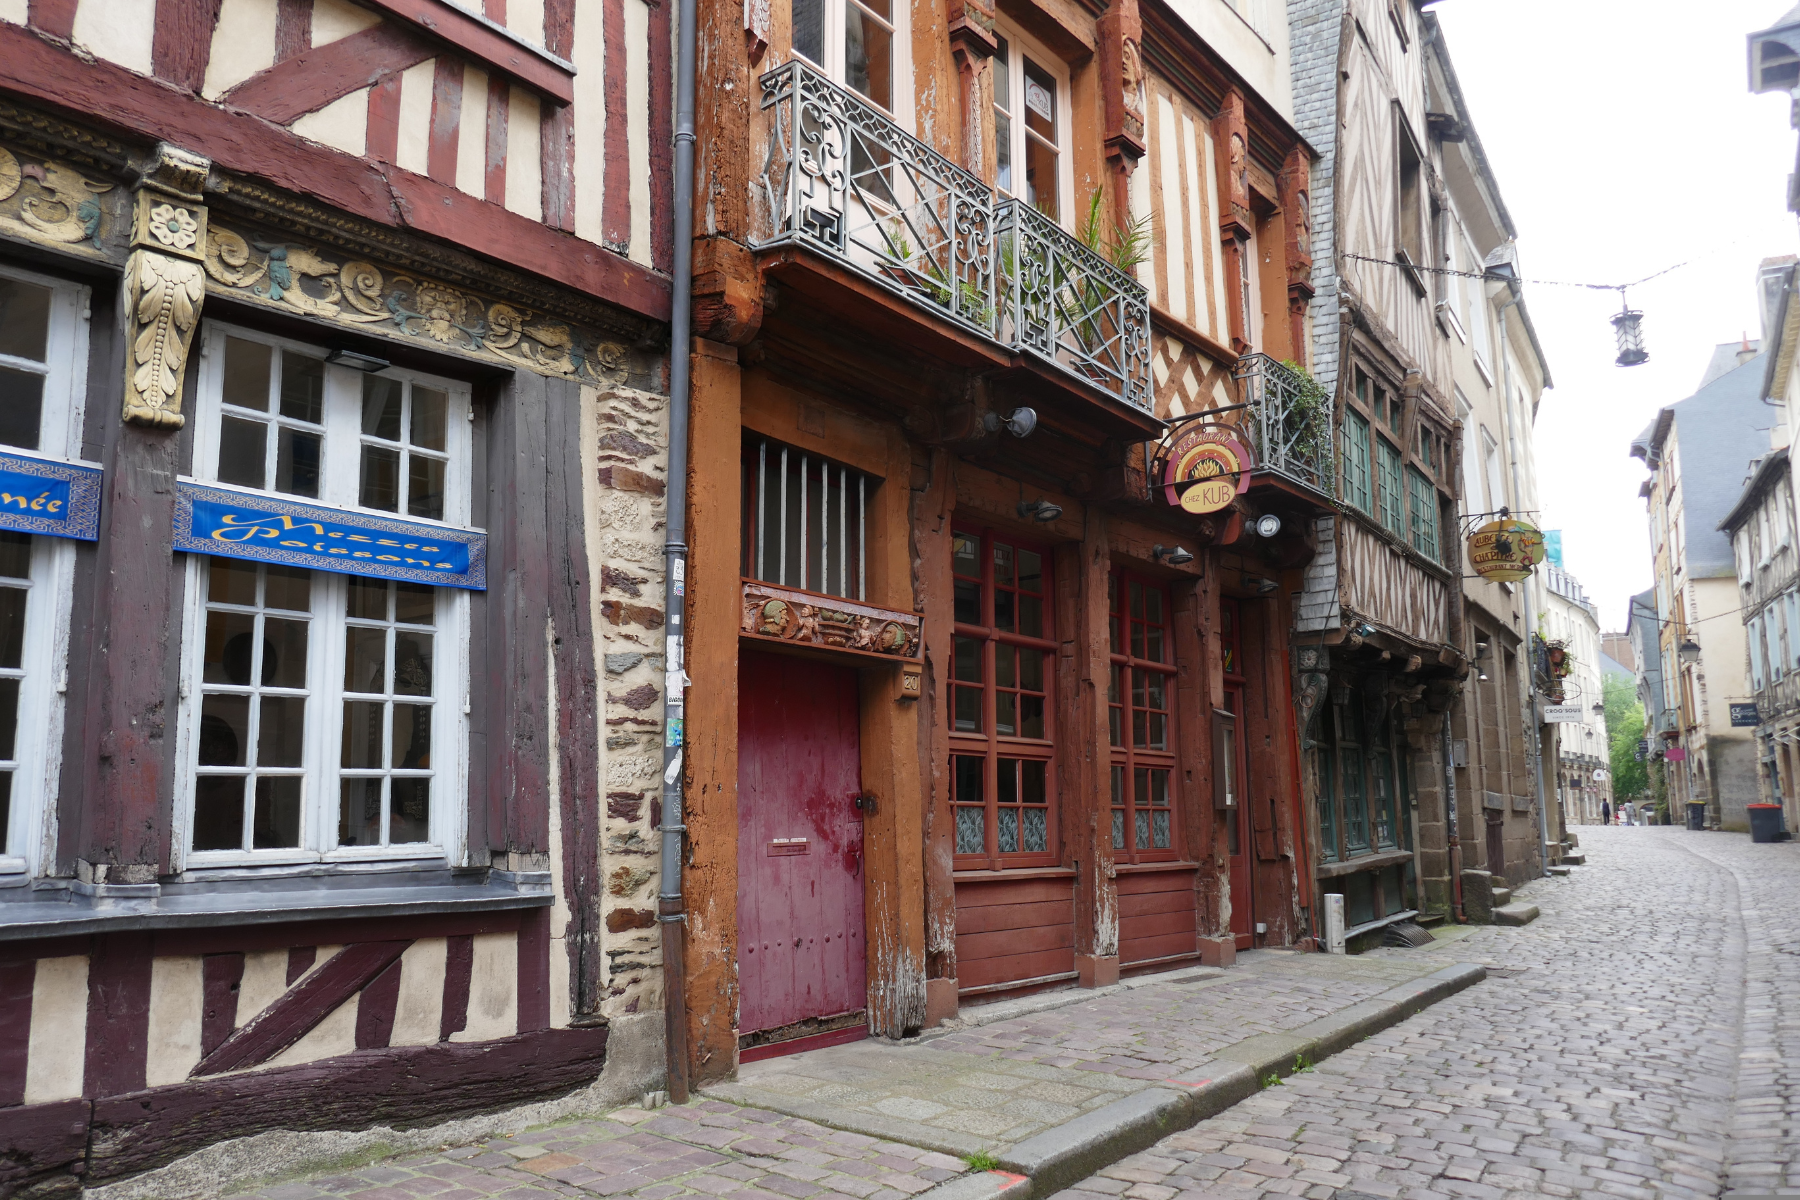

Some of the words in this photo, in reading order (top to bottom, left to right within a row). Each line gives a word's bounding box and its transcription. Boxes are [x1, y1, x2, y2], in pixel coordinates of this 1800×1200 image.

[1177, 432, 1233, 456] RESTAURANT
[1185, 494, 1200, 504] CHEZ
[1203, 485, 1231, 506] KUB
[222, 514, 440, 552] Mezzes
[1475, 534, 1512, 545] AUBEE
[211, 526, 453, 568] Poissons
[904, 675, 918, 690] 20
